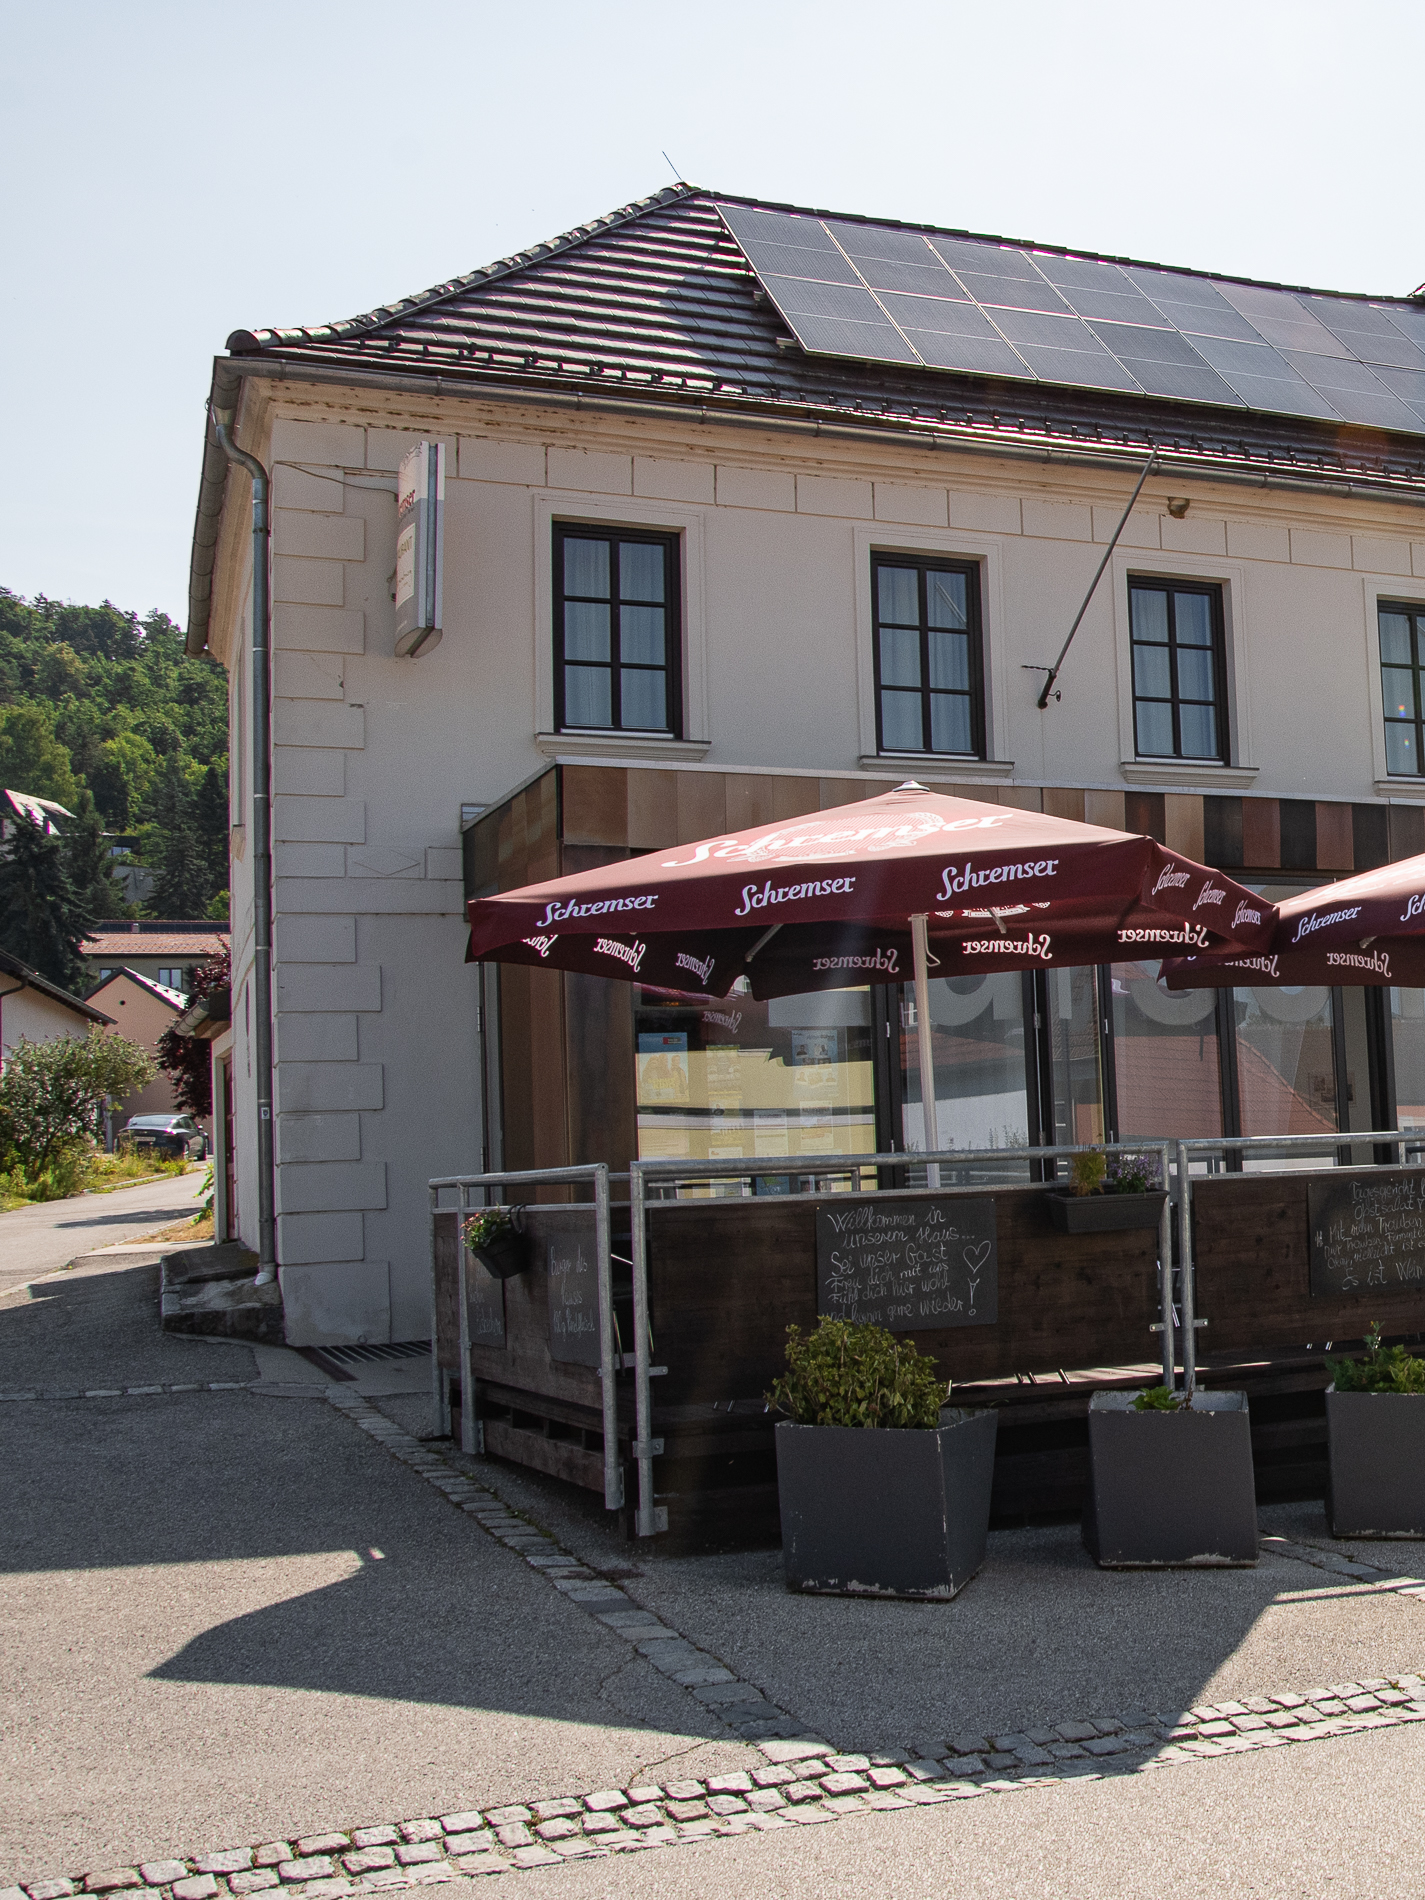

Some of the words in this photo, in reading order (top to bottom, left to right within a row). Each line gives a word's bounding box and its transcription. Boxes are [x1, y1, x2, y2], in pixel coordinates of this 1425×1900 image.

[660, 813, 1014, 868] Schremser
[936, 859, 1059, 901] Schremser
[1152, 863, 1190, 895] Schremser
[735, 875, 856, 916] Schremser
[536, 894, 658, 928] Schremser
[1292, 905, 1362, 943] Schremser
[1348, 1178, 1415, 1206] Tagesgericht
[826, 1205, 917, 1233] Willkommen
[924, 1205, 947, 1225] in
[1329, 1219, 1345, 1243] Mit
[841, 1230, 909, 1249] unserem
[1402, 1239, 1414, 1251] ist
[830, 1251, 855, 1276] Sei
[859, 1249, 901, 1268] unser
[905, 1243, 948, 1266] Gast
[1367, 1259, 1388, 1286] ist
[825, 1276, 862, 1294] Freu
[867, 1267, 895, 1285] dich
[899, 1264, 923, 1279] mit
[862, 1283, 888, 1300] dich
[891, 1277, 916, 1296] hier
[921, 1273, 950, 1292] wohl
[919, 1292, 964, 1317] wieder
